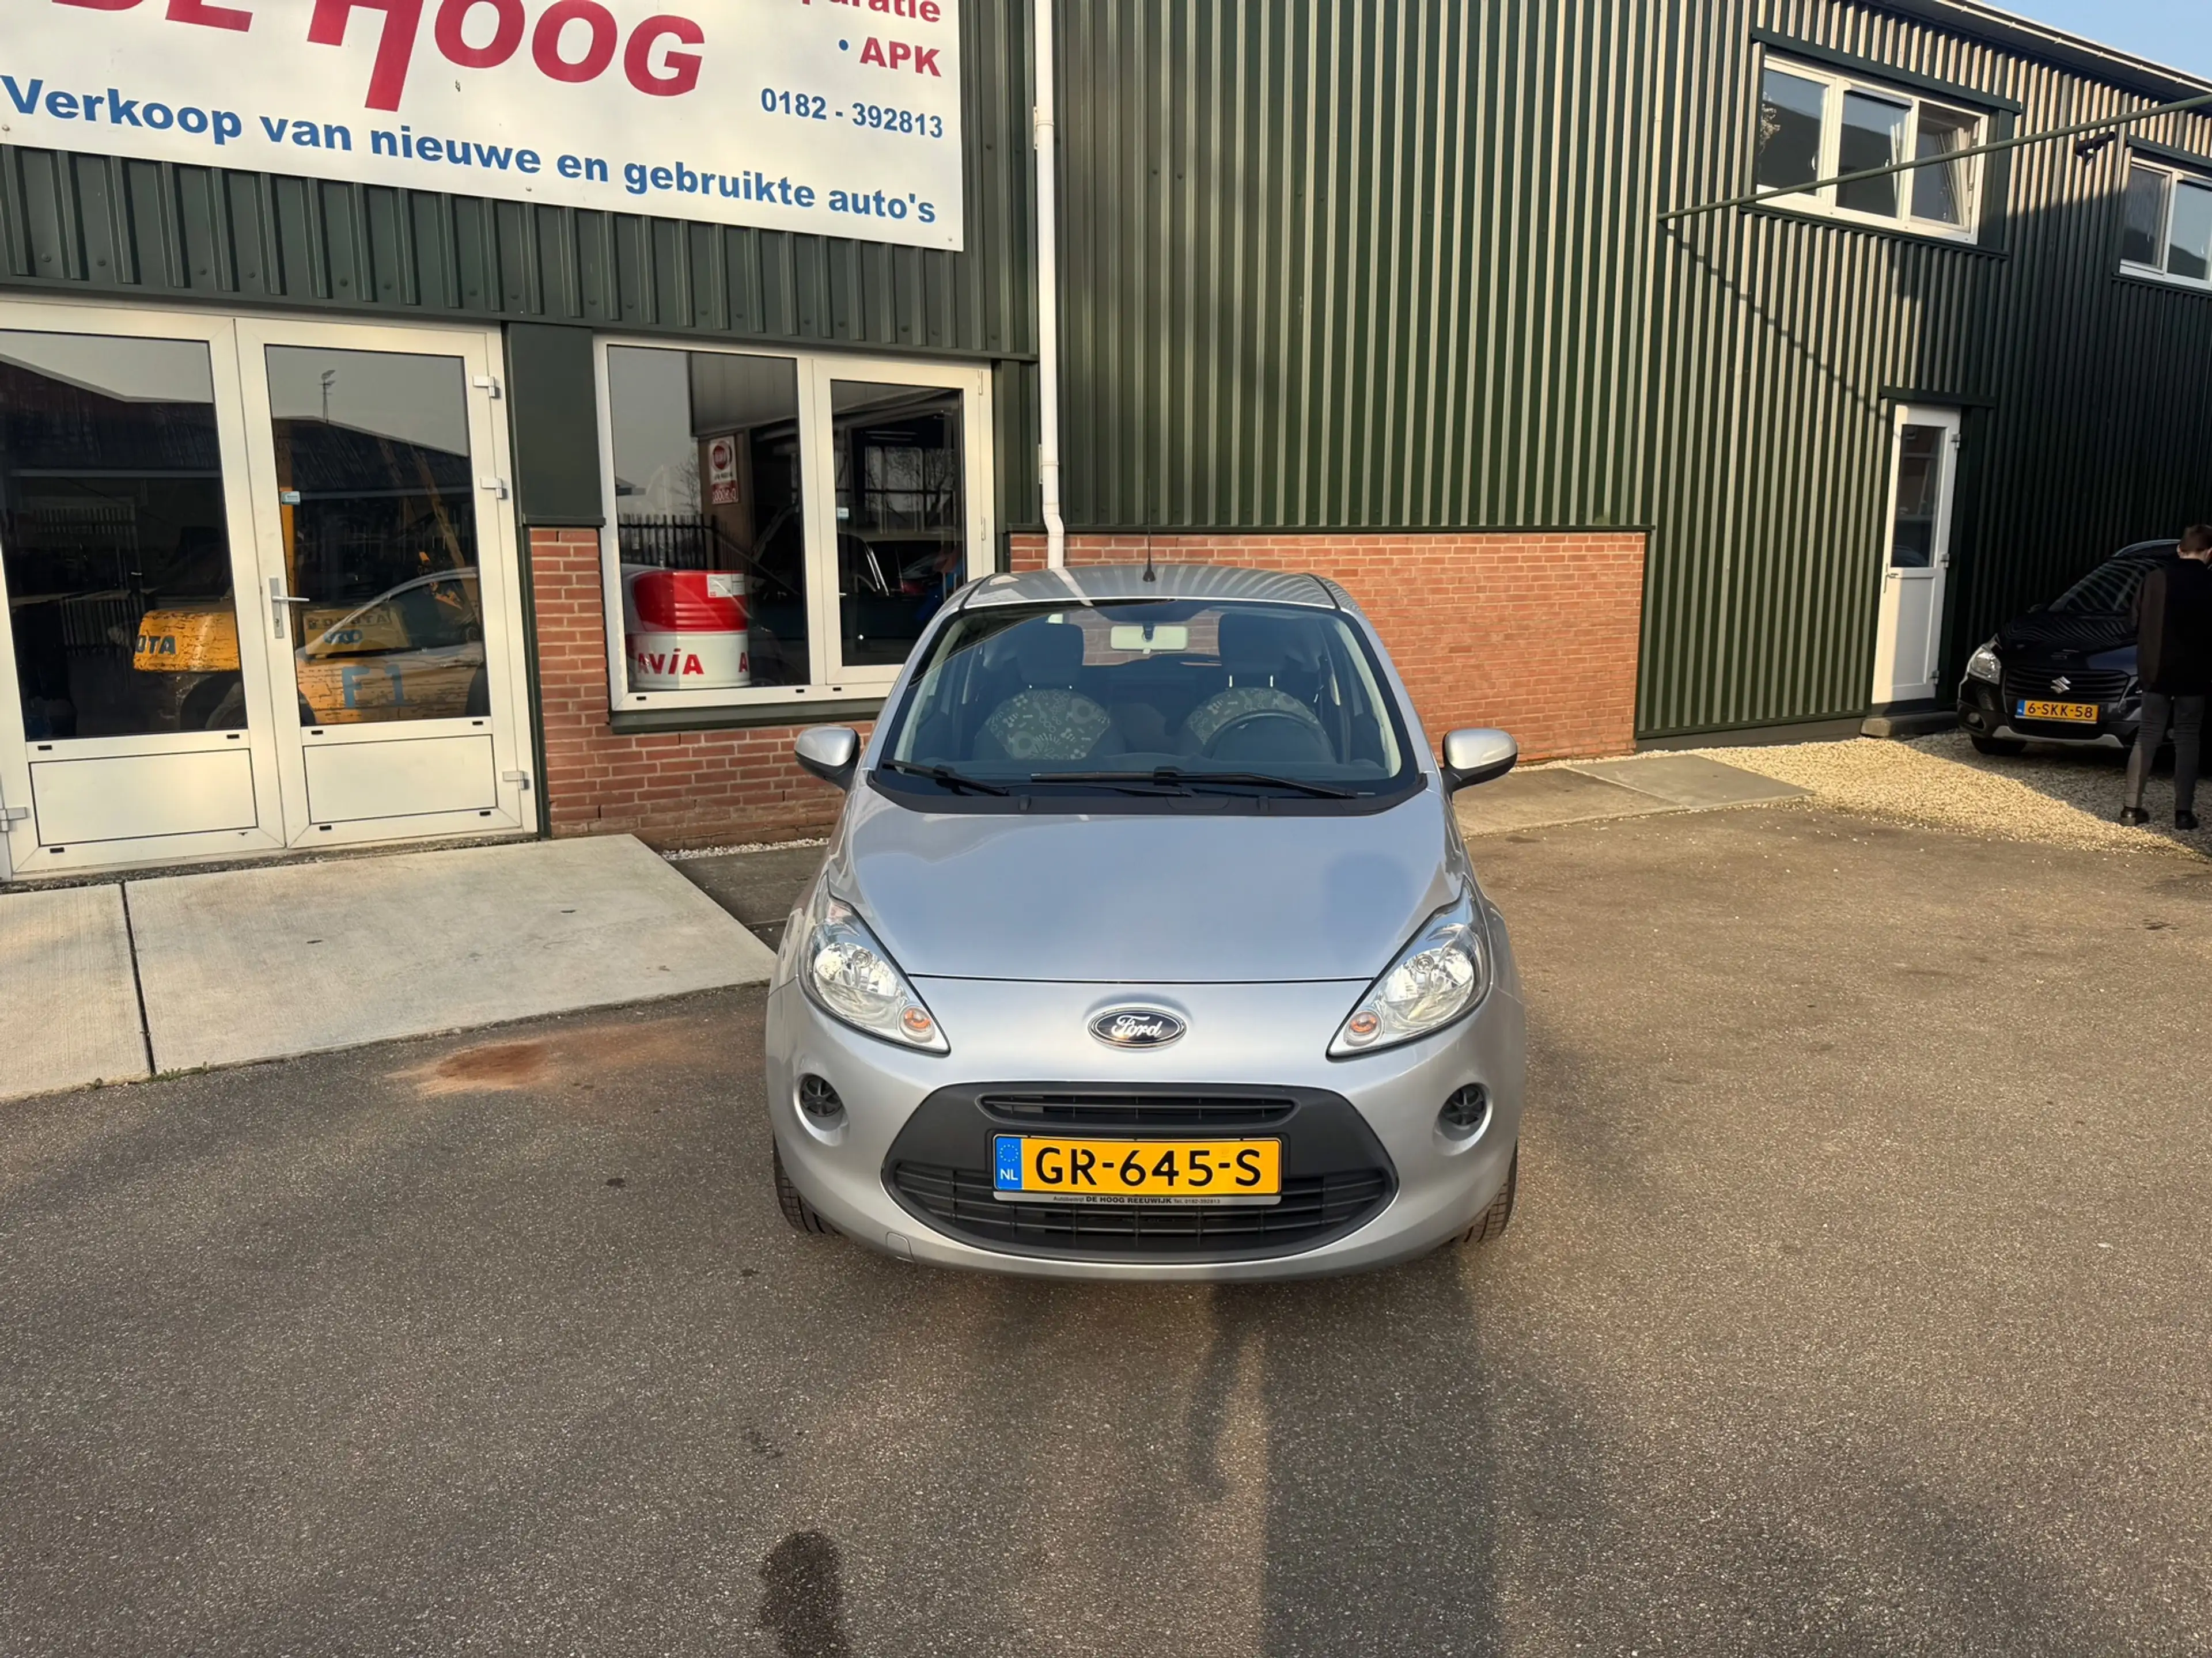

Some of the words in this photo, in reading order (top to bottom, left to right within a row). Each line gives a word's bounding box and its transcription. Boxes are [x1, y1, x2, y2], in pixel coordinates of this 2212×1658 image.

[859, 37, 941, 77] APK
[761, 88, 827, 120] 0182
[852, 103, 943, 138] 392813
[0, 75, 243, 145] Verkoop
[259, 116, 352, 151] van
[371, 125, 541, 174] nieuwe
[557, 154, 608, 182] en
[624, 161, 815, 208] gebruikte
[828, 189, 935, 223] auto's
[2028, 703, 2093, 718] 6-SKK-58
[1111, 1015, 1164, 1038] Ford
[1000, 1168, 1018, 1181] NL
[1036, 1147, 1262, 1186] GR-645-S
